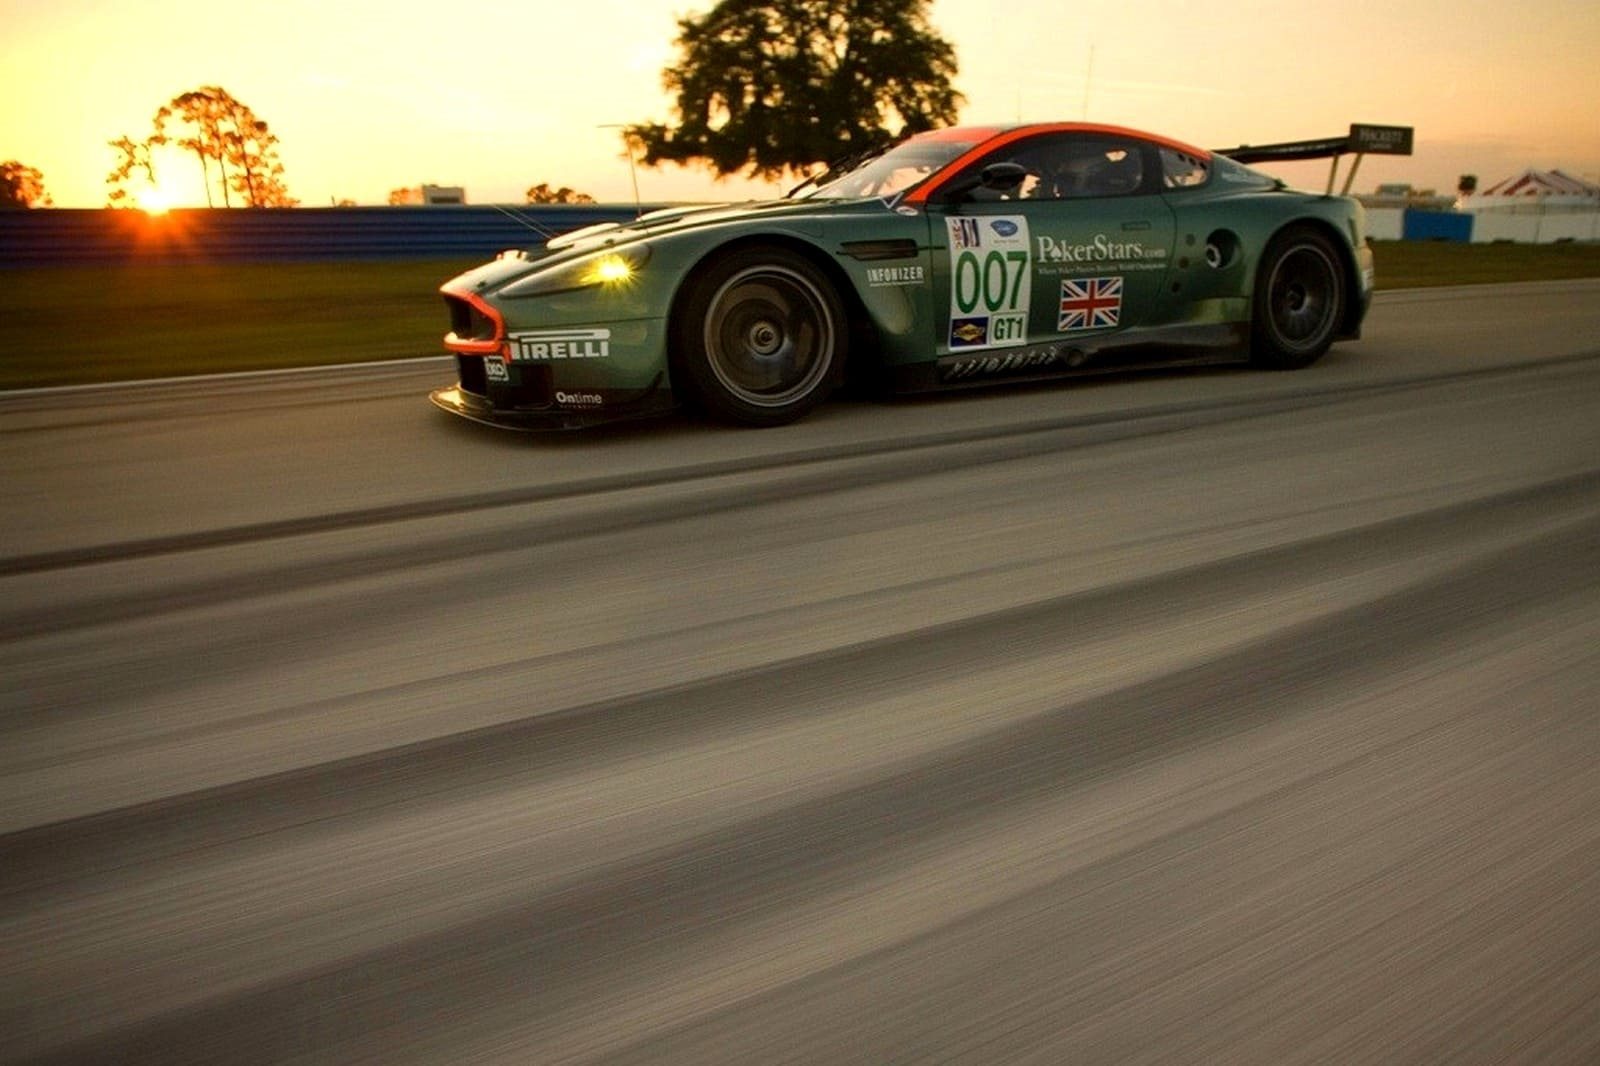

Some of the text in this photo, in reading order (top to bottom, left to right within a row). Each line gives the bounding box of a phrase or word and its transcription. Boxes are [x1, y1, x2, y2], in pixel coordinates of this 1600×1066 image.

[955, 250, 1027, 314] 007
[994, 318, 1024, 341] GT1
[508, 329, 610, 360] PIRELLI
[556, 392, 602, 404] Ontime
